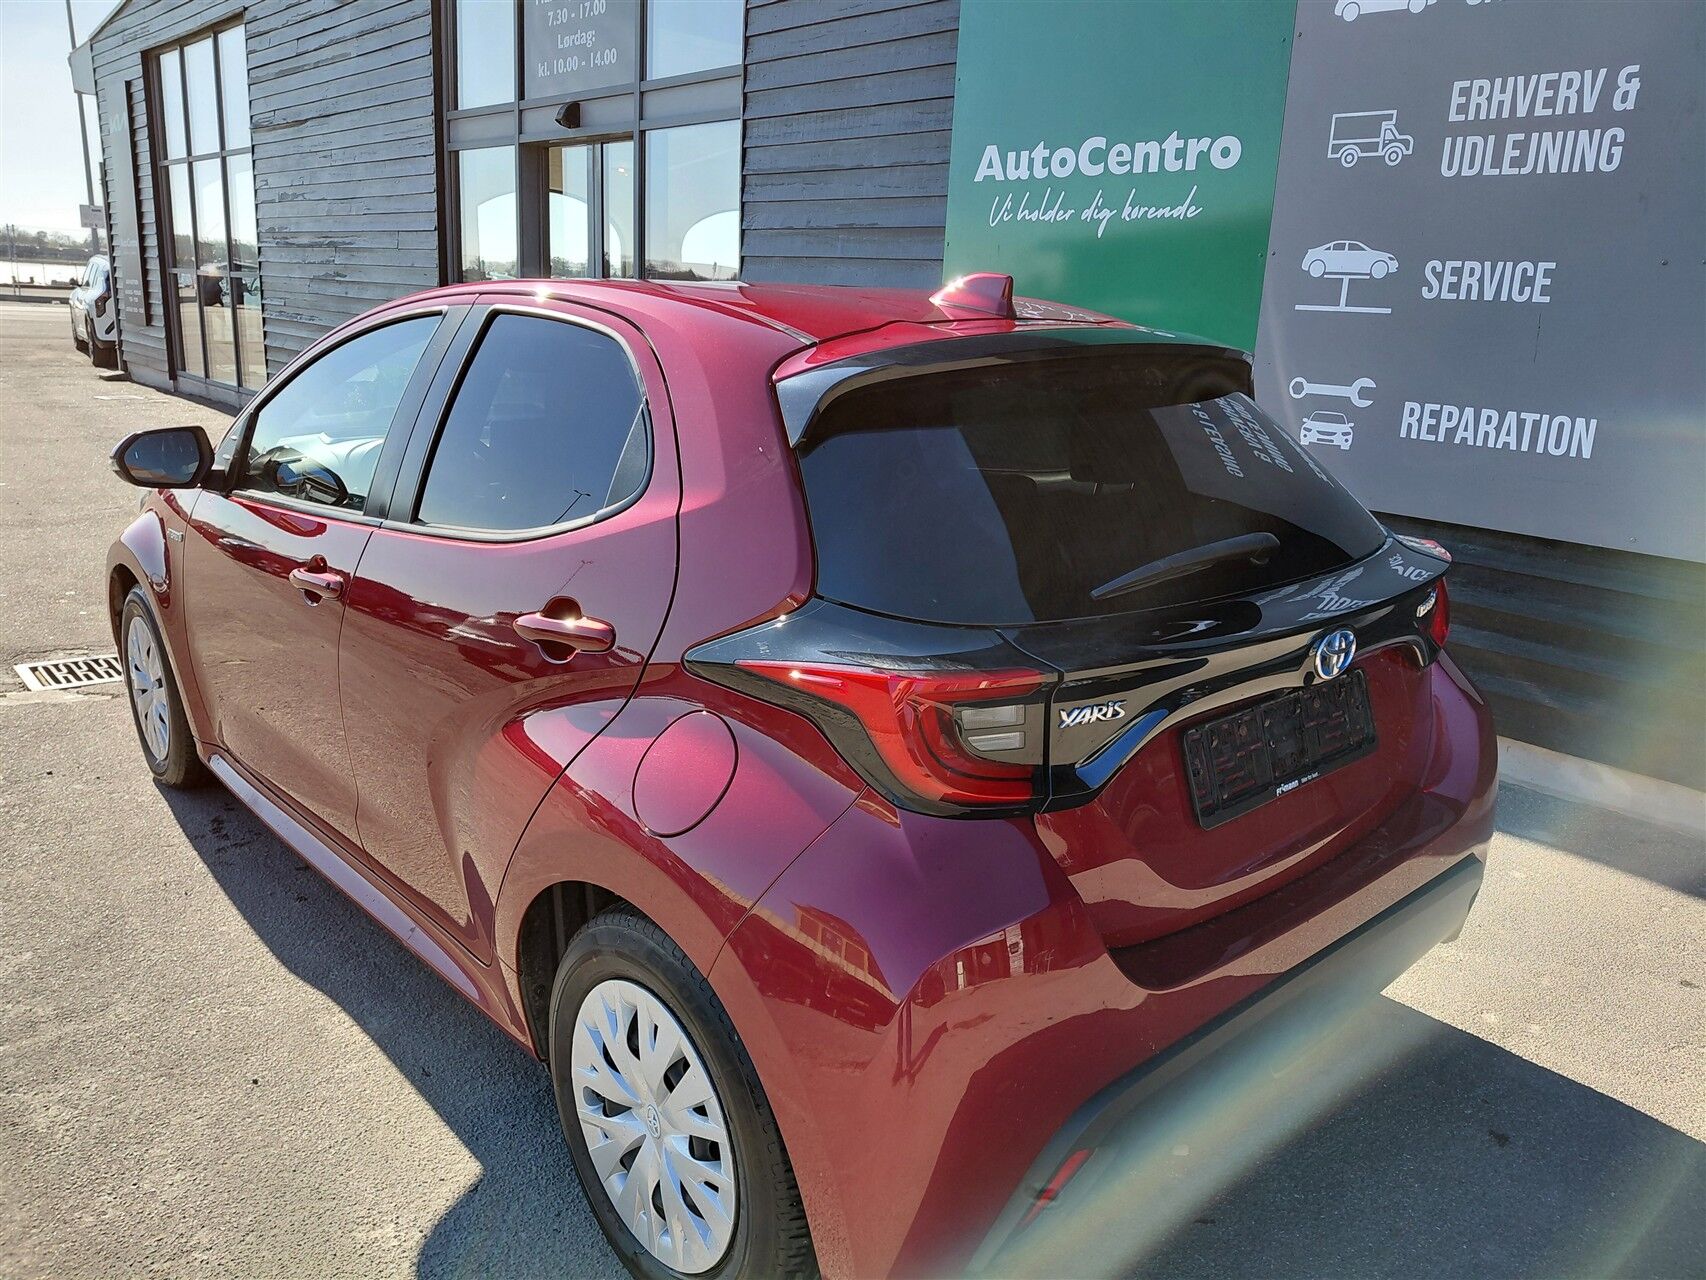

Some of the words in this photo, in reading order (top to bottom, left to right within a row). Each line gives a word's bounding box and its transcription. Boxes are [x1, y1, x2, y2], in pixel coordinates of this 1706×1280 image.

[548, 8, 568, 26] 7.30
[580, 0, 606, 19] 17.00
[538, 62, 550, 77] kl.
[554, 56, 578, 75] 10.00
[590, 48, 617, 68] 14.00
[558, 29, 596, 48] Lørdag:
[1448, 68, 1608, 122] ERHVERV
[1612, 64, 1641, 111] &
[973, 130, 1242, 182] AutoCentro
[1440, 127, 1625, 177] UDLEJNING
[989, 193, 1013, 227] Vi
[1016, 187, 1075, 223] holder
[1081, 189, 1118, 239] dig
[1121, 185, 1203, 222] kørende
[1421, 260, 1556, 303] SERVICE
[1400, 401, 1597, 459] REPARATION
